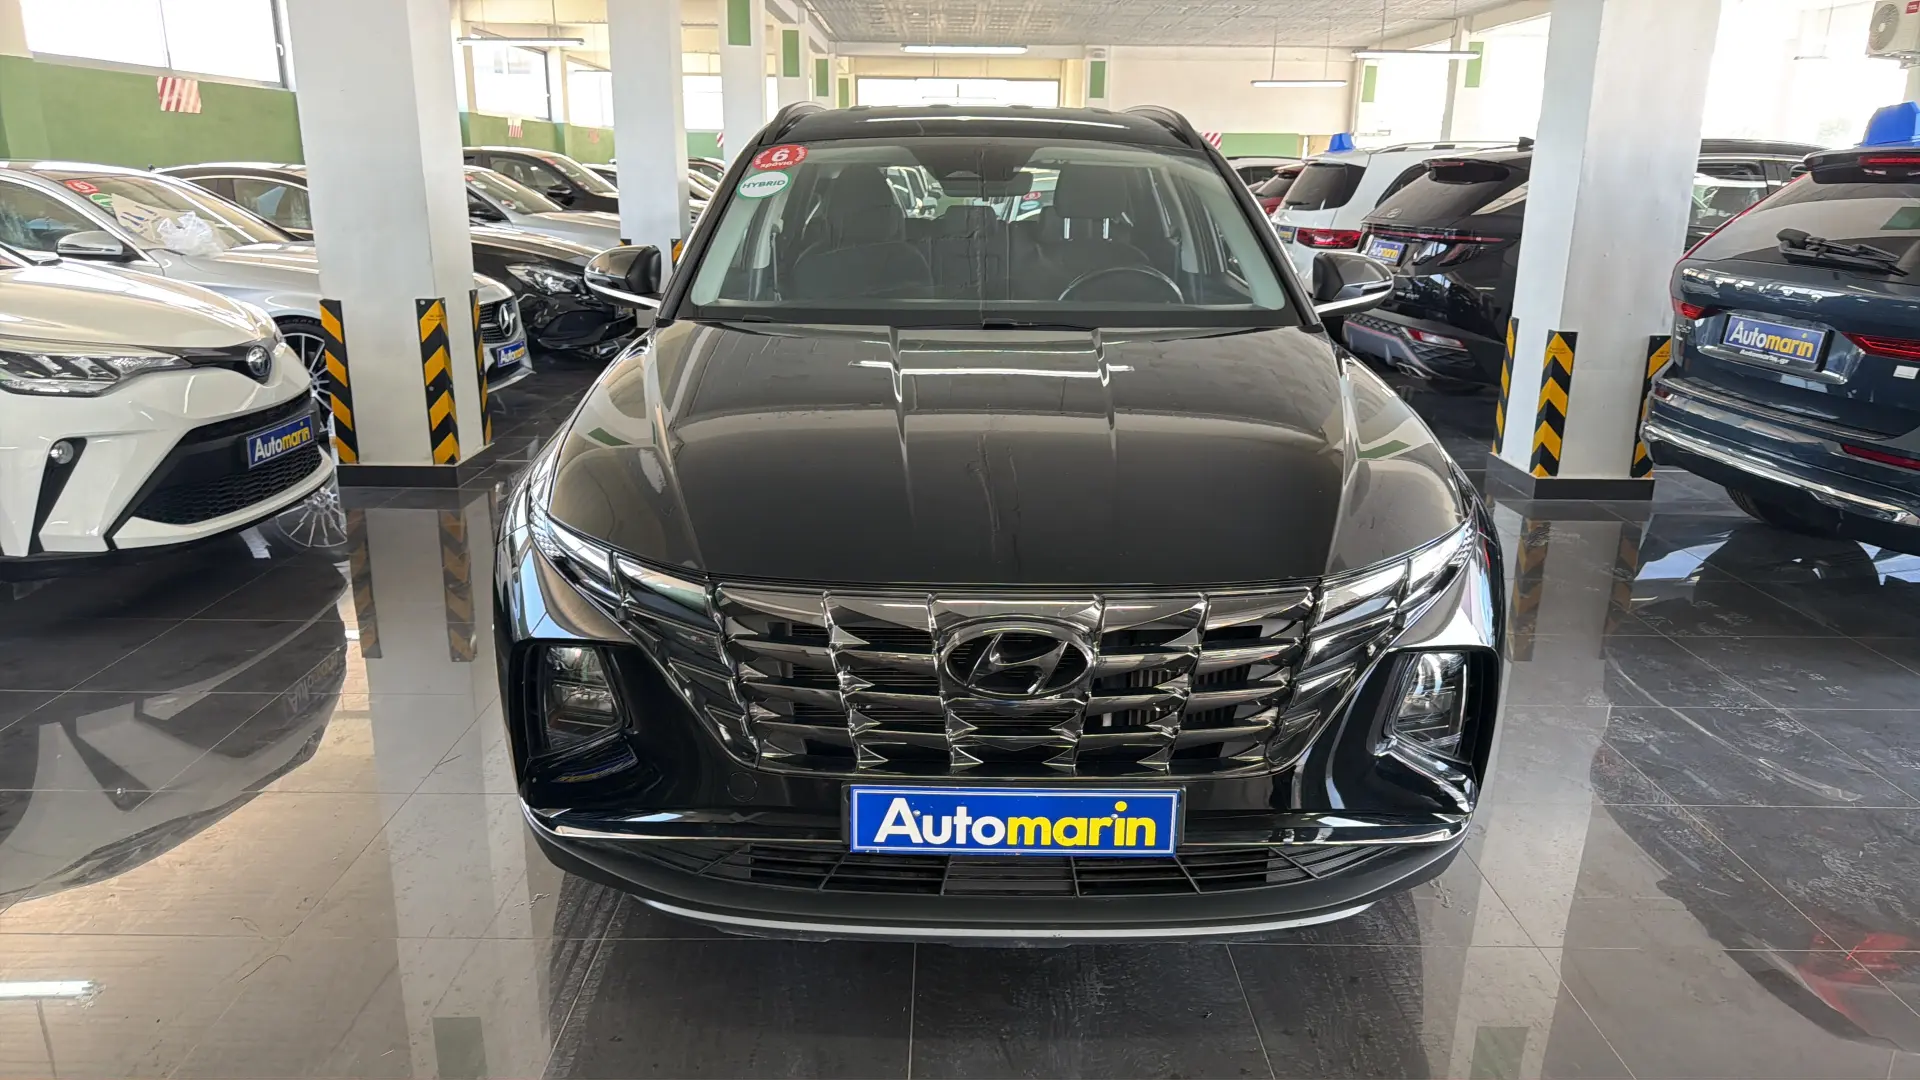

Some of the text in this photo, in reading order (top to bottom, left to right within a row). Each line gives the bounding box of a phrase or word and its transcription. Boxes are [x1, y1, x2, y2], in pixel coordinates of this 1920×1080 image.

[772, 149, 790, 162] 6
[742, 180, 786, 189] HYBRID
[1729, 321, 1815, 358] Automarin
[254, 421, 311, 462] Automarin
[873, 798, 1156, 846] Automarin
